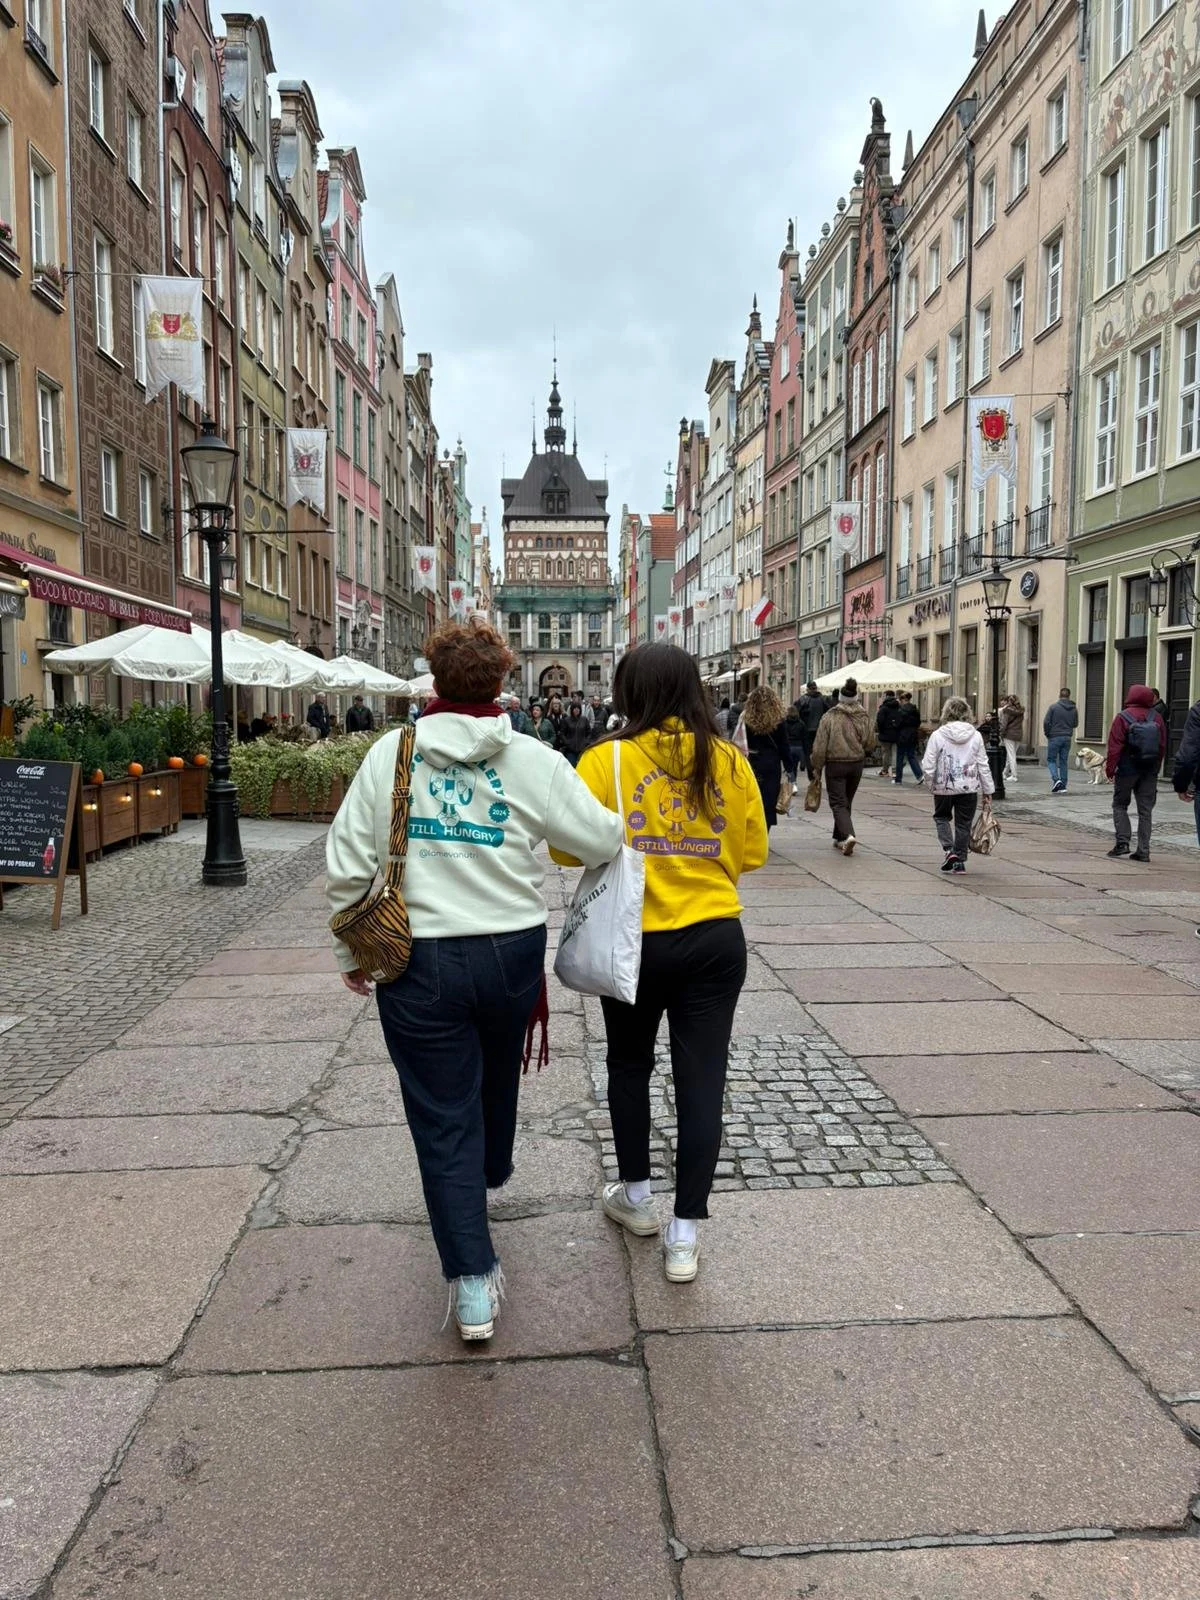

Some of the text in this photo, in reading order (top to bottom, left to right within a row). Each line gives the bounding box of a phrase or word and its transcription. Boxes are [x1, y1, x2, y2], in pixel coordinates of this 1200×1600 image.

[35, 577, 105, 610] FOOD & COCKTAILS
[908, 593, 951, 625] GRYCAN
[409, 823, 496, 842] TILL HUNGRY
[637, 841, 717, 853] STILL HUNGRY
